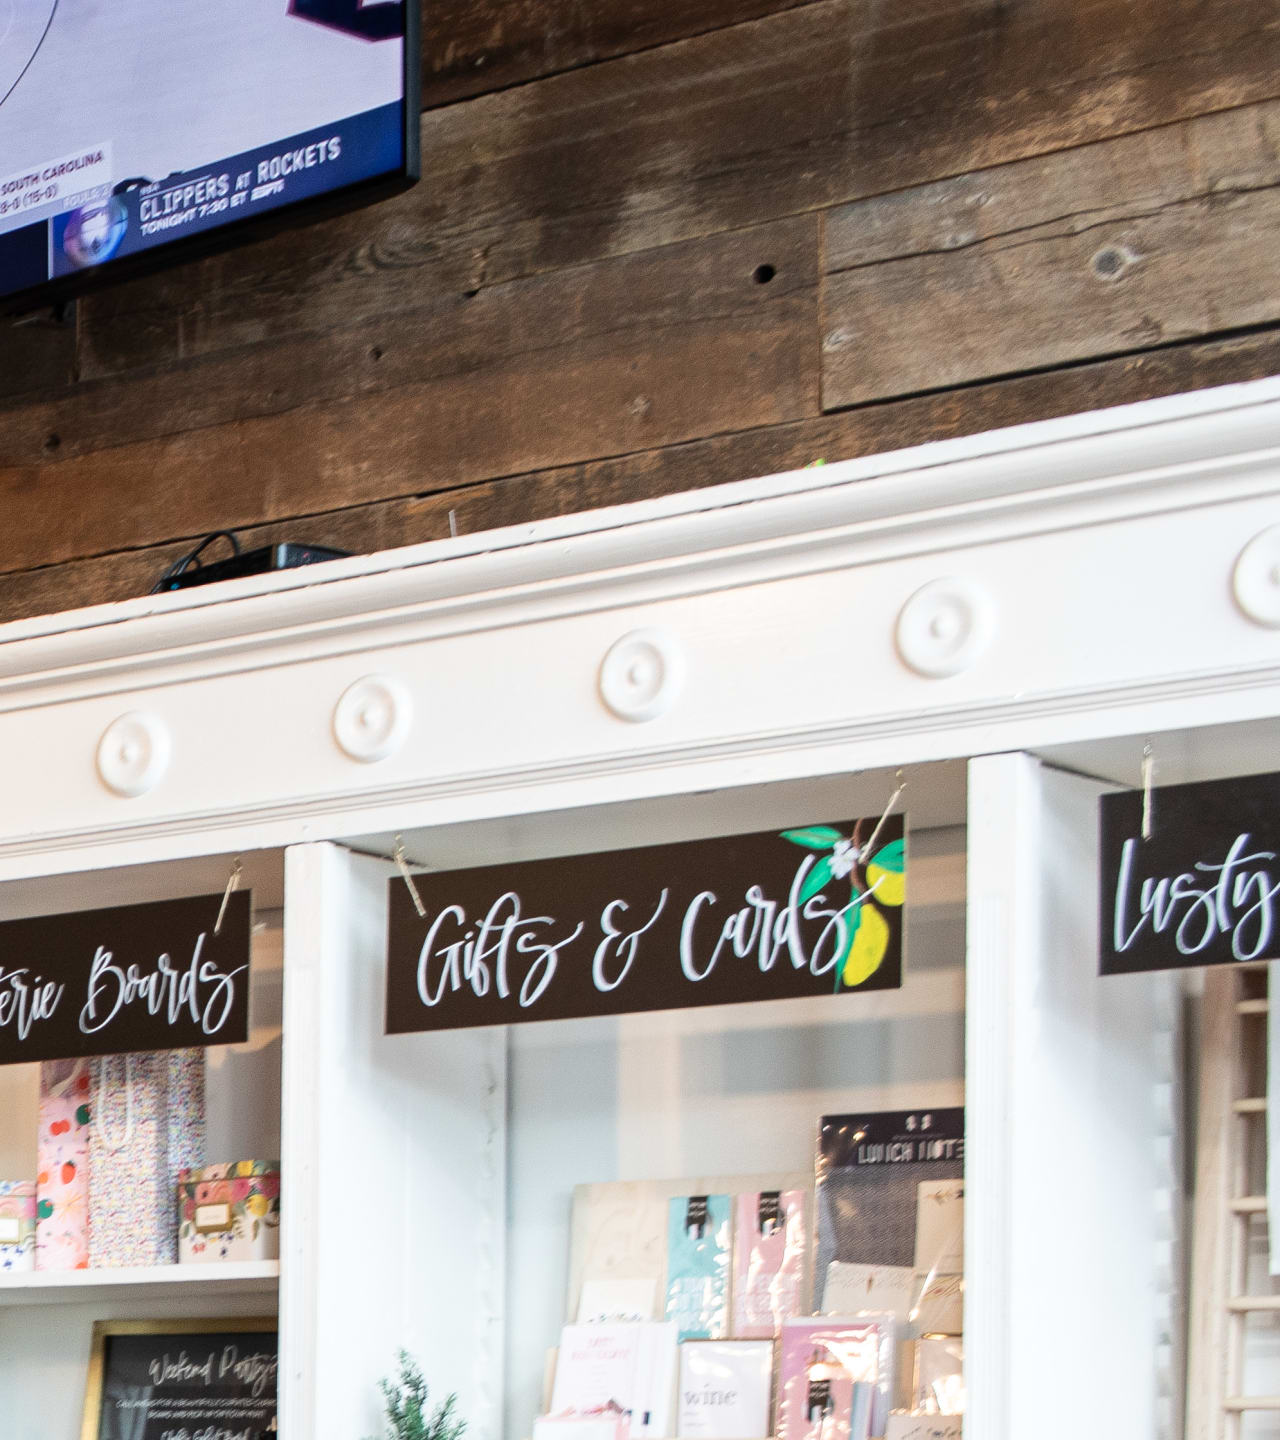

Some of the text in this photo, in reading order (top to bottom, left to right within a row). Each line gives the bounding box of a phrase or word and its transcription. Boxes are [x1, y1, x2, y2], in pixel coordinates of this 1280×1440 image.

[1, 174, 40, 196] SOUTH
[42, 150, 104, 183] CAROLINA
[139, 135, 342, 223] CLIPPERS AT ROCKETS
[140, 206, 197, 238] TONIGHT
[416, 853, 888, 1008] Gifts & Cards
[78, 932, 251, 1036] Boards
